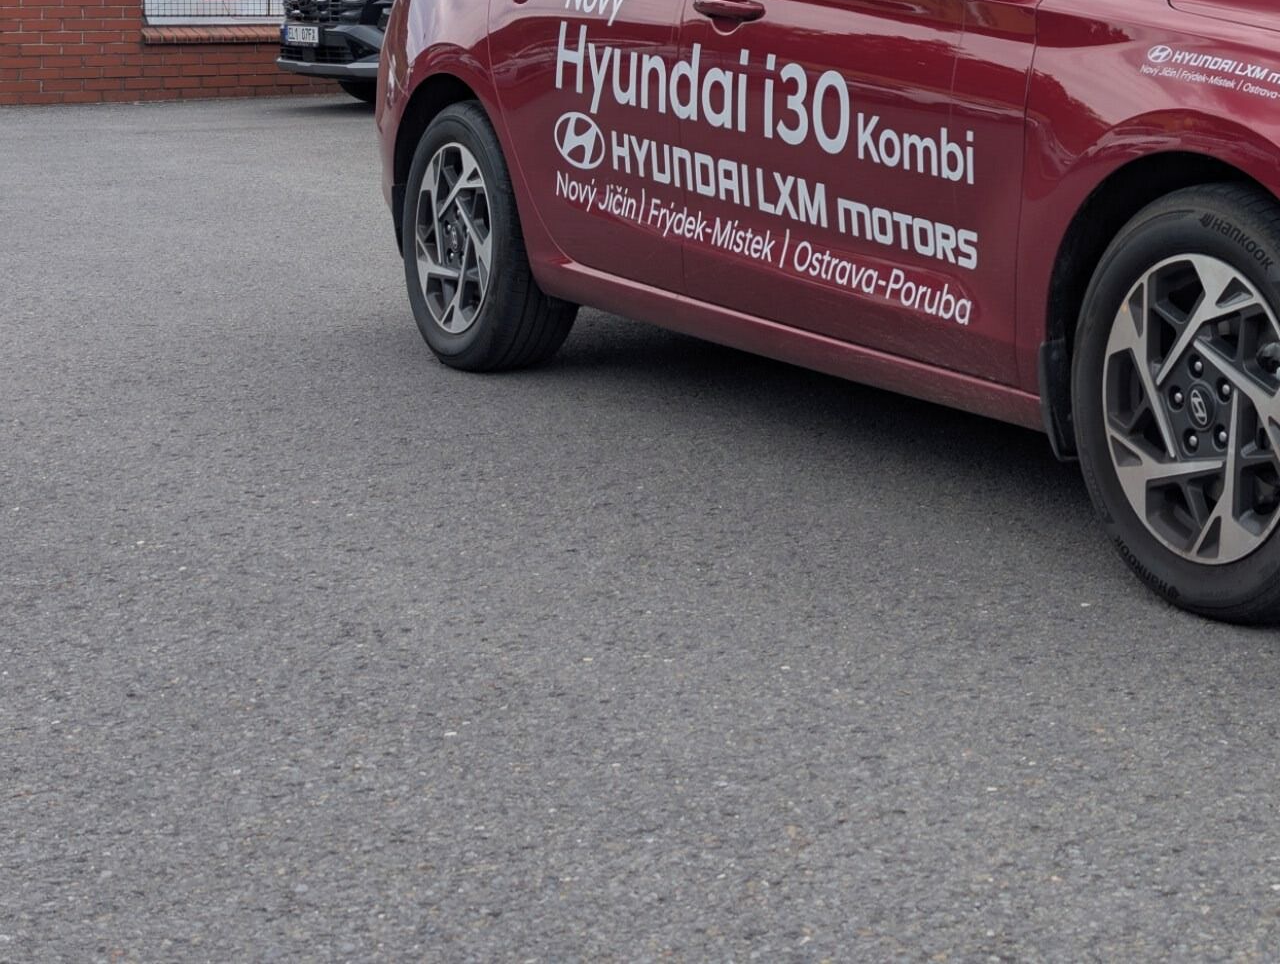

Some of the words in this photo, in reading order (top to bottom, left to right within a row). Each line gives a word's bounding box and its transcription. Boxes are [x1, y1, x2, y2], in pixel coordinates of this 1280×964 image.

[556, 20, 749, 132] Hyundai
[763, 54, 850, 154] i30
[858, 112, 975, 185] Kombi
[1172, 50, 1236, 73] HYUNDAI
[1235, 62, 1269, 80] LXM
[556, 170, 598, 212] Nový
[599, 181, 636, 220] Jičín
[647, 198, 775, 262] Frýdek-Místek
[794, 240, 972, 326] Ostrava-Poruba
[611, 129, 750, 206] HYUNDAI
[757, 166, 828, 228] LXM
[838, 197, 978, 270] MOTORS
